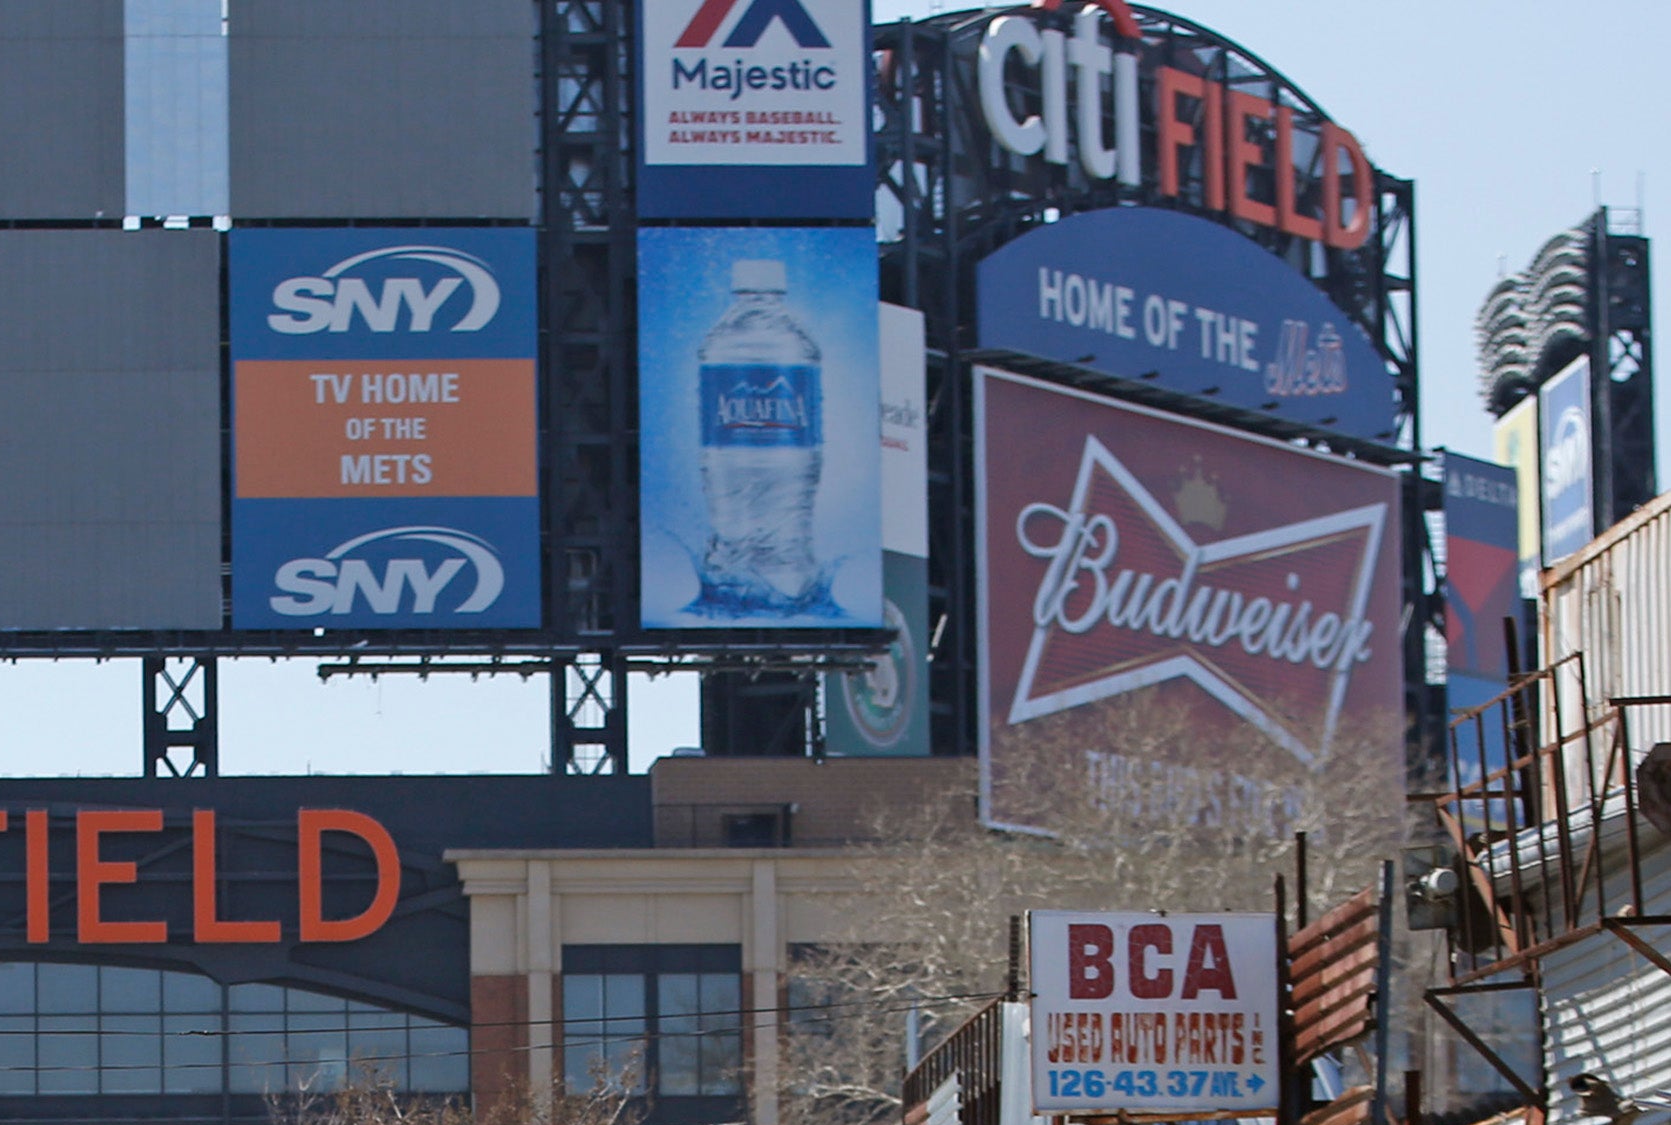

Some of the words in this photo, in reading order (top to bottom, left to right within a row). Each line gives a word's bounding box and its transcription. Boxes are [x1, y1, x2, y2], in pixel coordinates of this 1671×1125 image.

[672, 57, 837, 100] Majestic
[668, 111, 741, 125] ALWAYS
[745, 111, 842, 125] BASEBALL.
[668, 131, 741, 144] ALWAYS
[745, 131, 842, 144] MAJESTIC.
[1154, 64, 1374, 251] FIELD
[266, 276, 464, 335] SNY
[1038, 266, 1136, 340] HOME
[1143, 294, 1188, 350] OF
[1195, 307, 1260, 371] THE
[310, 374, 353, 404] TV
[361, 373, 460, 404] HOME
[718, 394, 807, 427] AQUAFINA
[345, 418, 378, 440] OF
[381, 418, 427, 440] THE
[340, 453, 433, 485] METS
[268, 558, 467, 617] SNY
[1017, 502, 1374, 670] Budweiser
[1068, 923, 1238, 1000] BCA
[1047, 1012, 1104, 1064] USED
[1110, 1012, 1167, 1065] AUTO
[1174, 1012, 1245, 1065] PARTS
